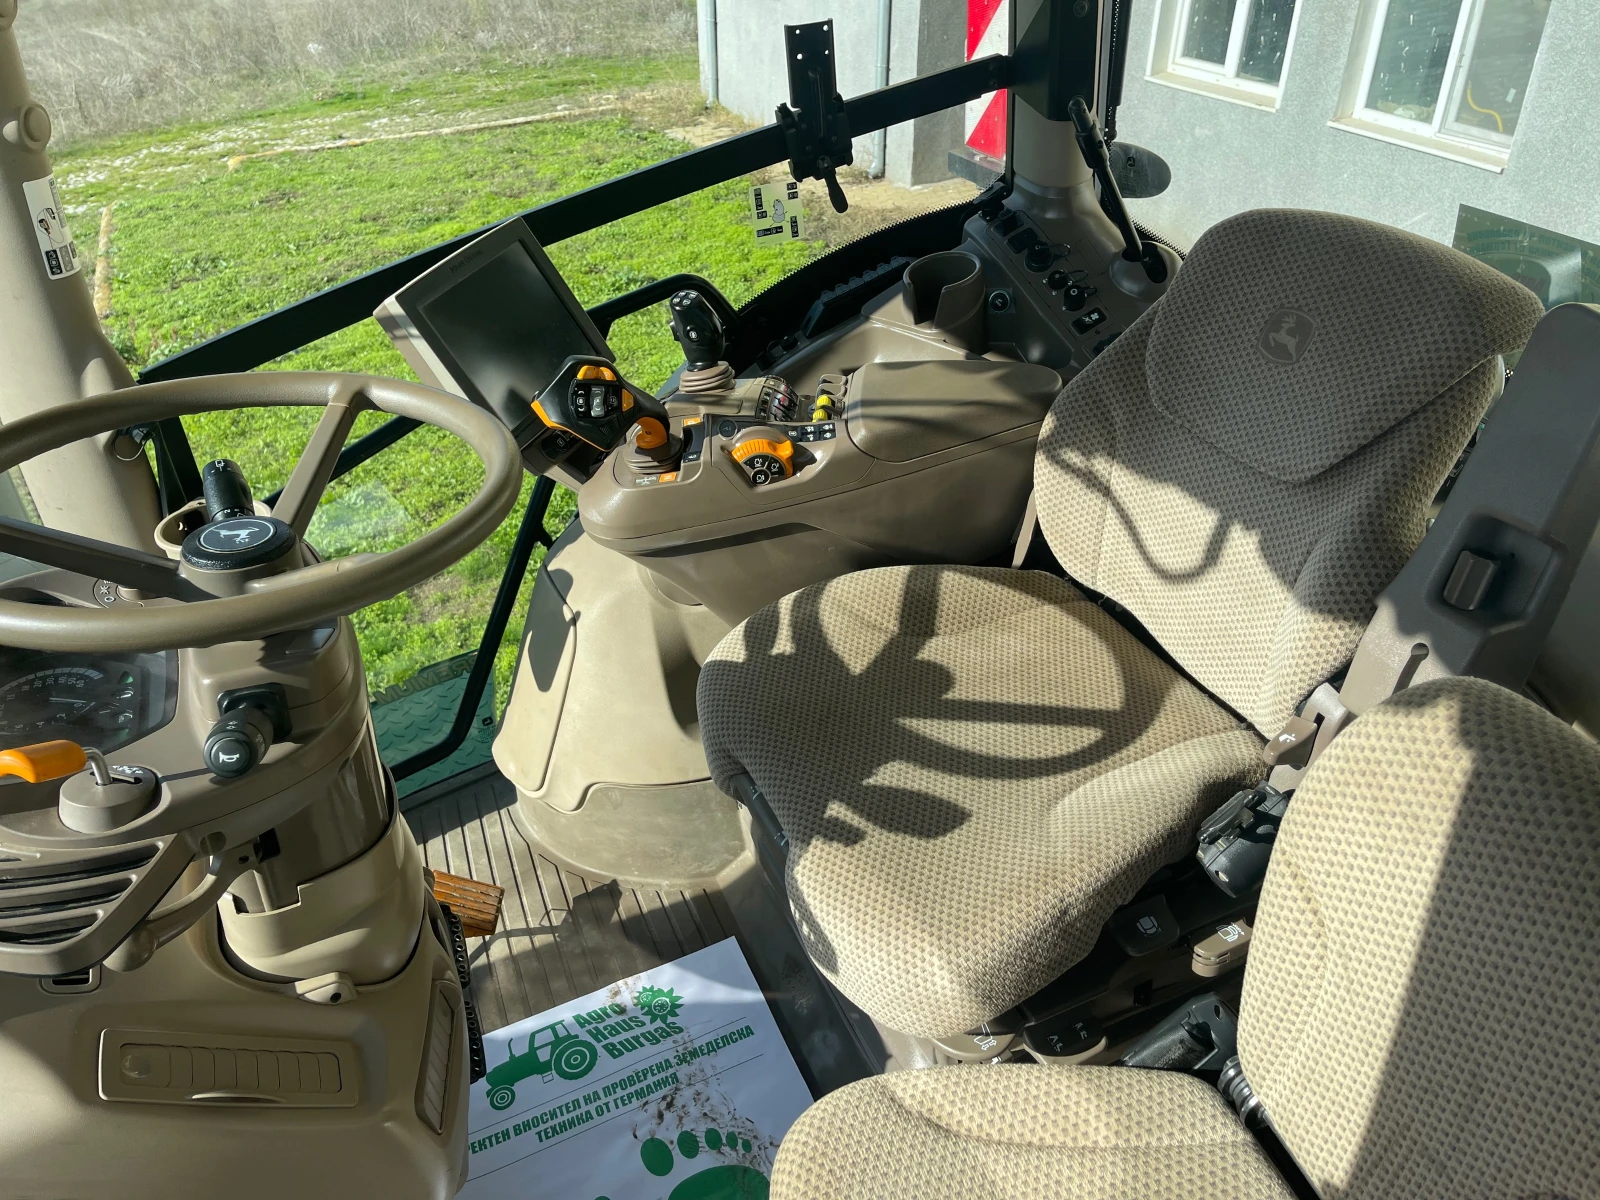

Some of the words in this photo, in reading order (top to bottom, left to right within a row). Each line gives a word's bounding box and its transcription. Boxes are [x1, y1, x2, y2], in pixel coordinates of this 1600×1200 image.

[68, 677, 77, 685] 50
[572, 1002, 627, 1029] Agro
[586, 1016, 647, 1044] Haus
[602, 1021, 684, 1060] Burgas
[512, 1098, 582, 1137] ВНОСИТЕЛ
[582, 1090, 602, 1107] НА
[601, 1058, 674, 1098] ПРОВЕРЕНА
[673, 1025, 755, 1067] ЗЕМЕДЕЛСКА
[535, 1109, 595, 1143] ТЕХНИКА
[594, 1101, 612, 1118] ОТ
[613, 1071, 680, 1110] ГЕРМАНИЯ
